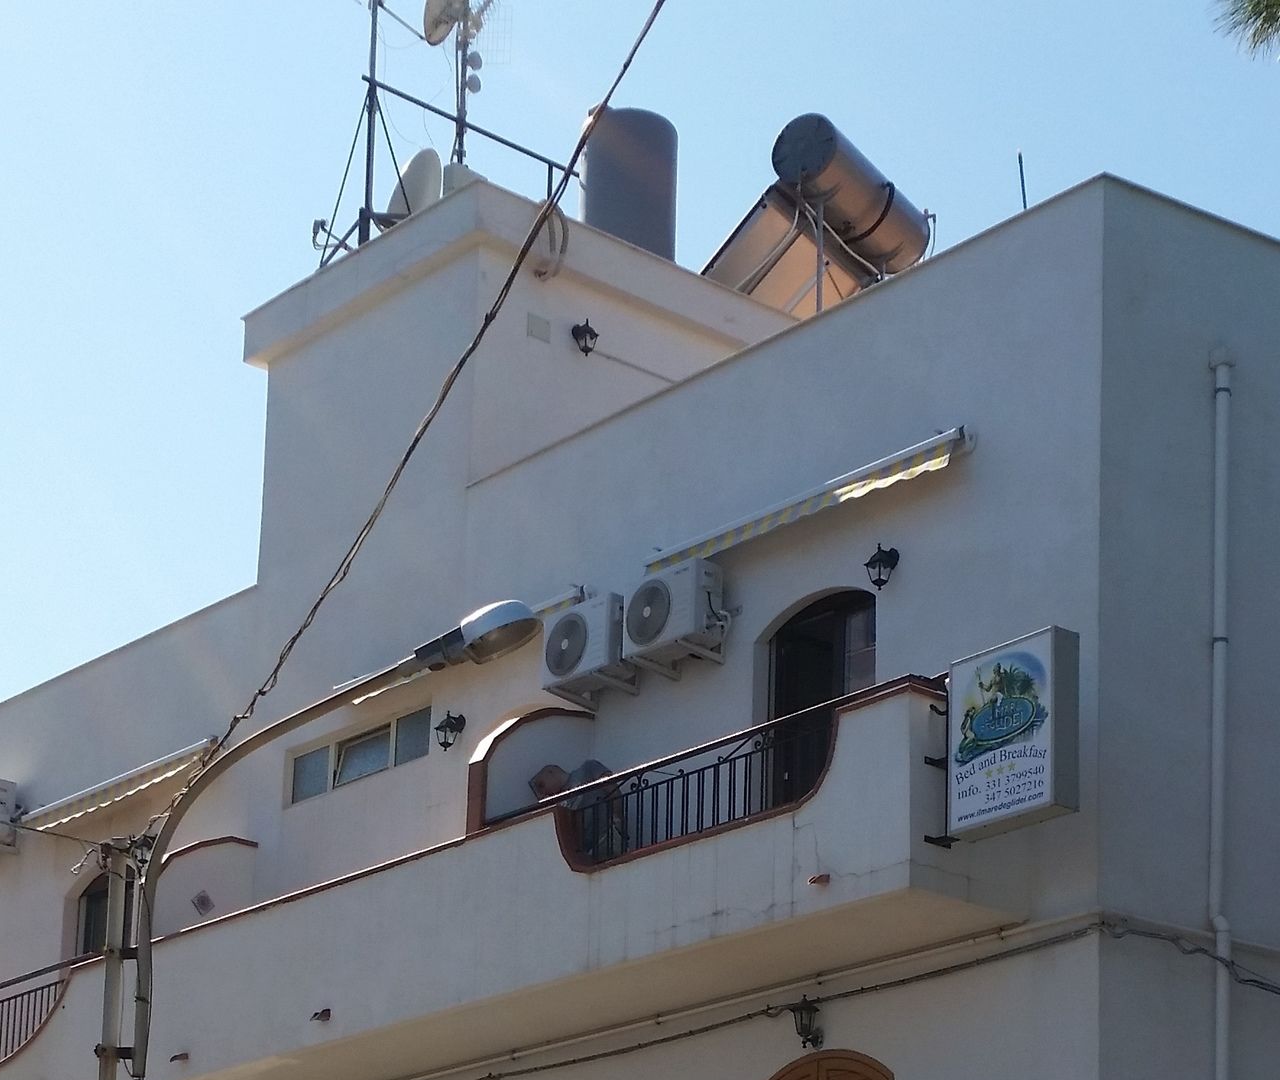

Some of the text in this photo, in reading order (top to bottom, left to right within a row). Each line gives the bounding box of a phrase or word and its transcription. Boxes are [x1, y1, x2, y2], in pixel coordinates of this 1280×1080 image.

[955, 745, 1047, 785] Bed and Breakfast
[957, 784, 982, 800] info.
[986, 778, 1001, 792] 331
[985, 790, 1002, 804] 347
